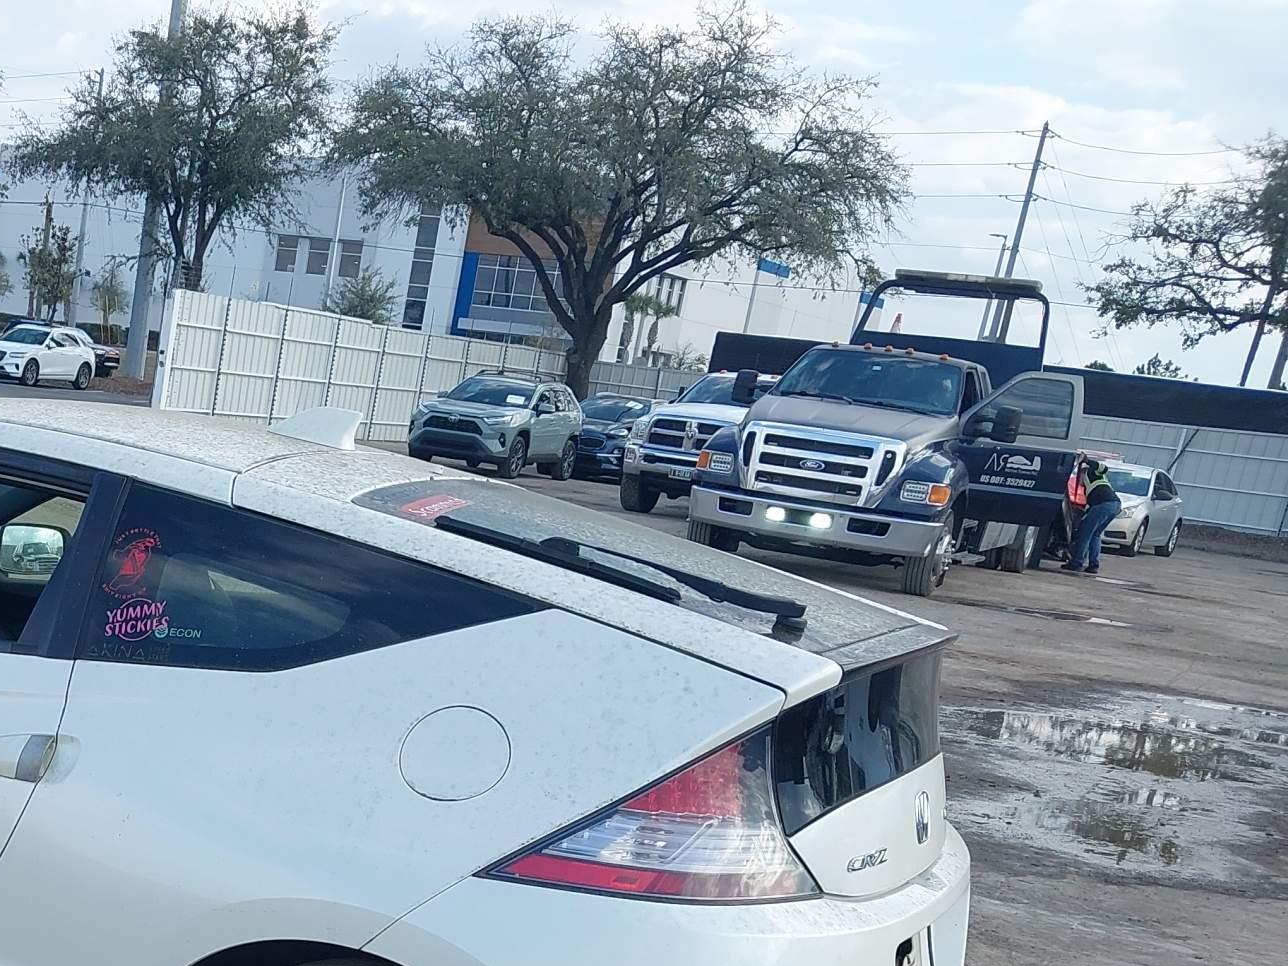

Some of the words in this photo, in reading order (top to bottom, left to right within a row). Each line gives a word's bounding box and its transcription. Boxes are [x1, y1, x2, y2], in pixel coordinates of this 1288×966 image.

[979, 474, 990, 483] US
[990, 475, 1006, 485] DOT:
[106, 600, 168, 623] YUMMY
[104, 616, 170, 637] STICKIES
[169, 626, 202, 639] ECON
